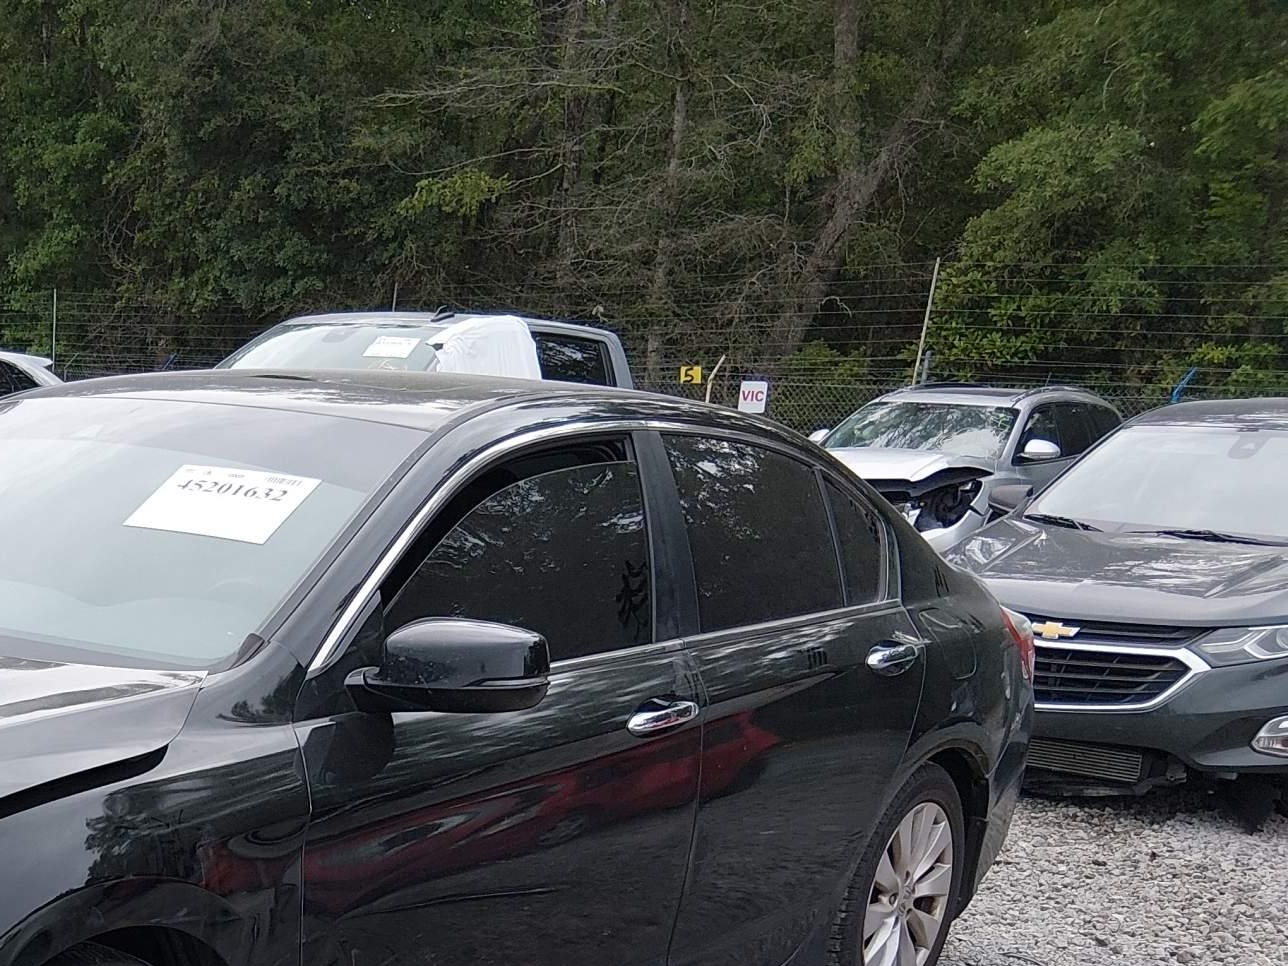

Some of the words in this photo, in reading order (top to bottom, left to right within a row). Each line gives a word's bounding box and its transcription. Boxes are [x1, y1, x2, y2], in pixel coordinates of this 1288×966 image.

[682, 367, 694, 383] 5
[741, 390, 764, 402] VIC
[177, 479, 288, 502] 45201632
